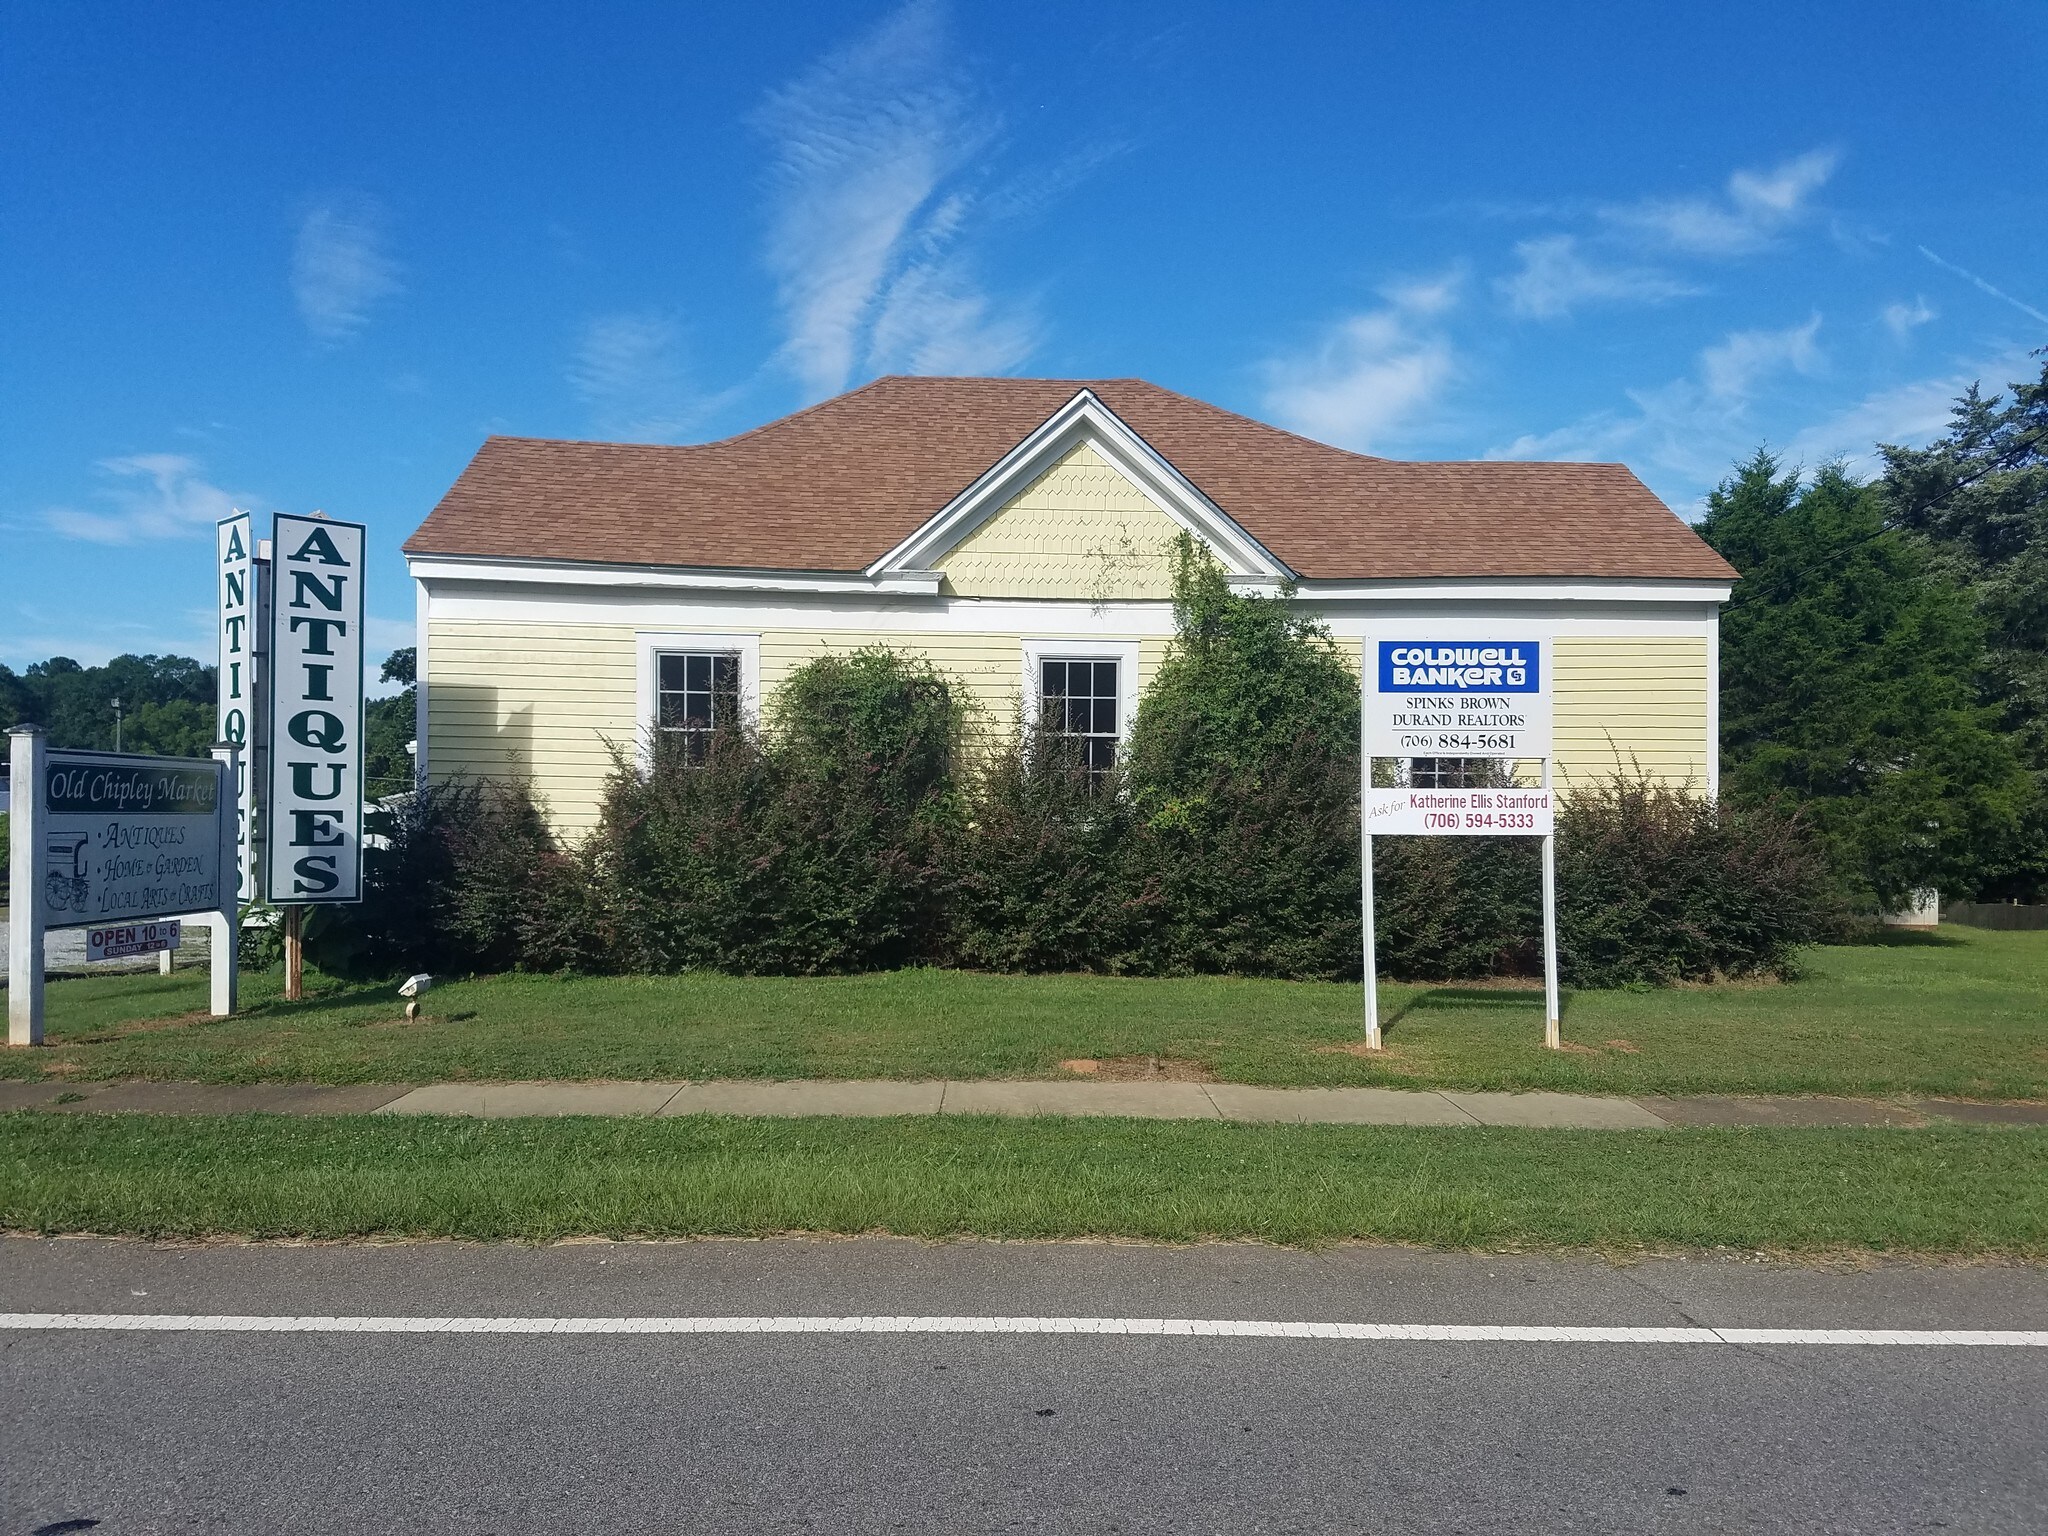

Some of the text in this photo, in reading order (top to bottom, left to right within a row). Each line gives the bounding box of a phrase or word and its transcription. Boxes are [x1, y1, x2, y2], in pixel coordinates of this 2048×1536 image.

[1391, 648, 1527, 666] COLDWELL
[1392, 667, 1503, 688] BANKER
[287, 527, 351, 894] ANTIQUES
[1406, 697, 1511, 710] SPINKS BROWN
[1392, 714, 1525, 727] DURAND REALTORS
[1400, 734, 1516, 750] (706) 884-5681
[51, 770, 214, 809] Old Chipley Market
[1369, 800, 1406, 819] Ask for
[1410, 794, 1548, 809] Katherine Ellis Stanford
[1424, 813, 1534, 829] (706) 594-5333
[103, 822, 186, 850] ANTIQUES
[103, 854, 144, 882] HOME
[155, 853, 204, 882] GARDEN
[100, 887, 139, 913] LOCAL
[141, 887, 168, 910] ARTS
[178, 882, 214, 905] CRAFTS
[91, 922, 178, 948] OPEN 10 to 6
[106, 943, 143, 956] SUNDAY
[147, 942, 155, 950] 12
